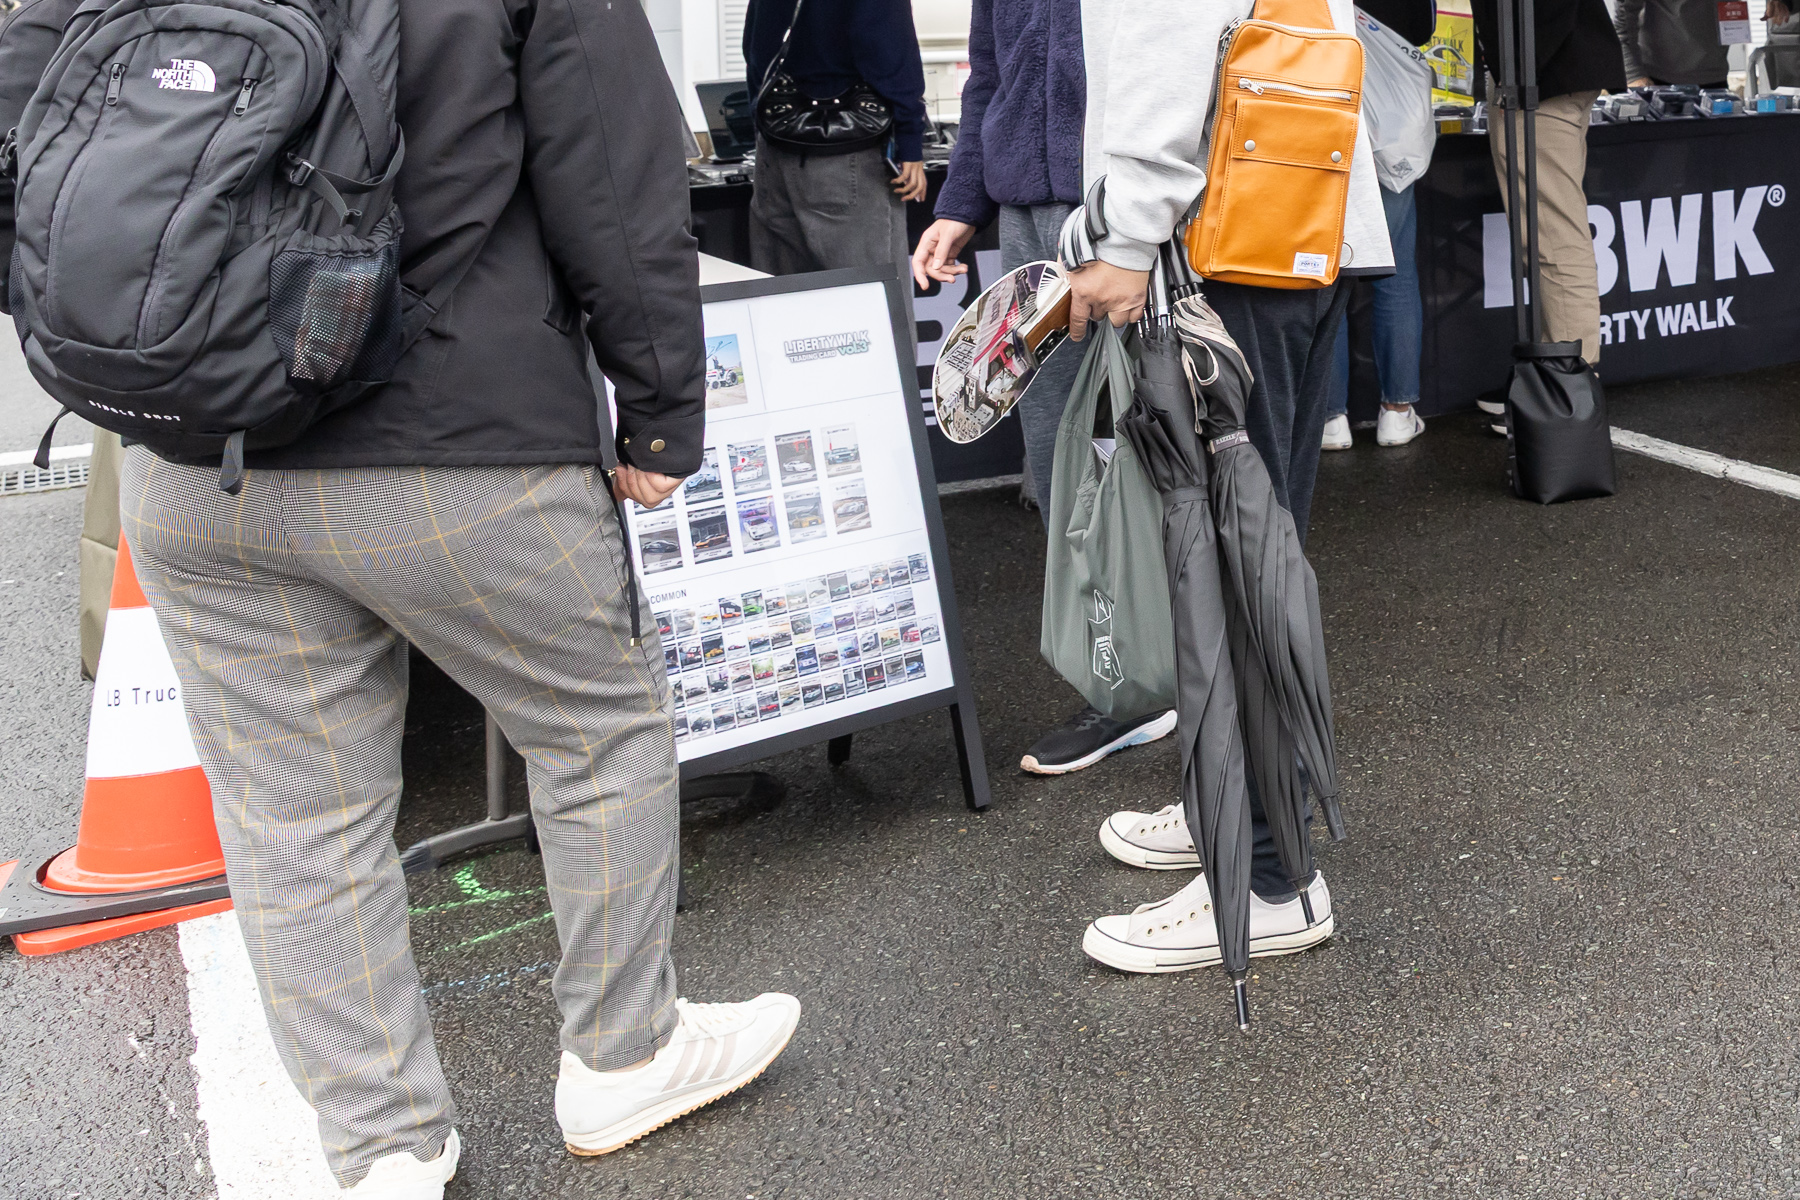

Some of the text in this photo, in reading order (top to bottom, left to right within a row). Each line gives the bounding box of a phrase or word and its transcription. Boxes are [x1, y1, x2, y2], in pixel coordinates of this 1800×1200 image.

[170, 58, 195, 71] THE
[151, 68, 194, 82] NORTH
[158, 78, 192, 91] FACE
[1655, 296, 1737, 338] WALK
[784, 329, 871, 356] LIBERTY WALK
[789, 351, 818, 364] TRADING
[818, 349, 837, 360] CARD
[650, 588, 688, 605] COMMON
[107, 687, 177, 707] LB Truc
